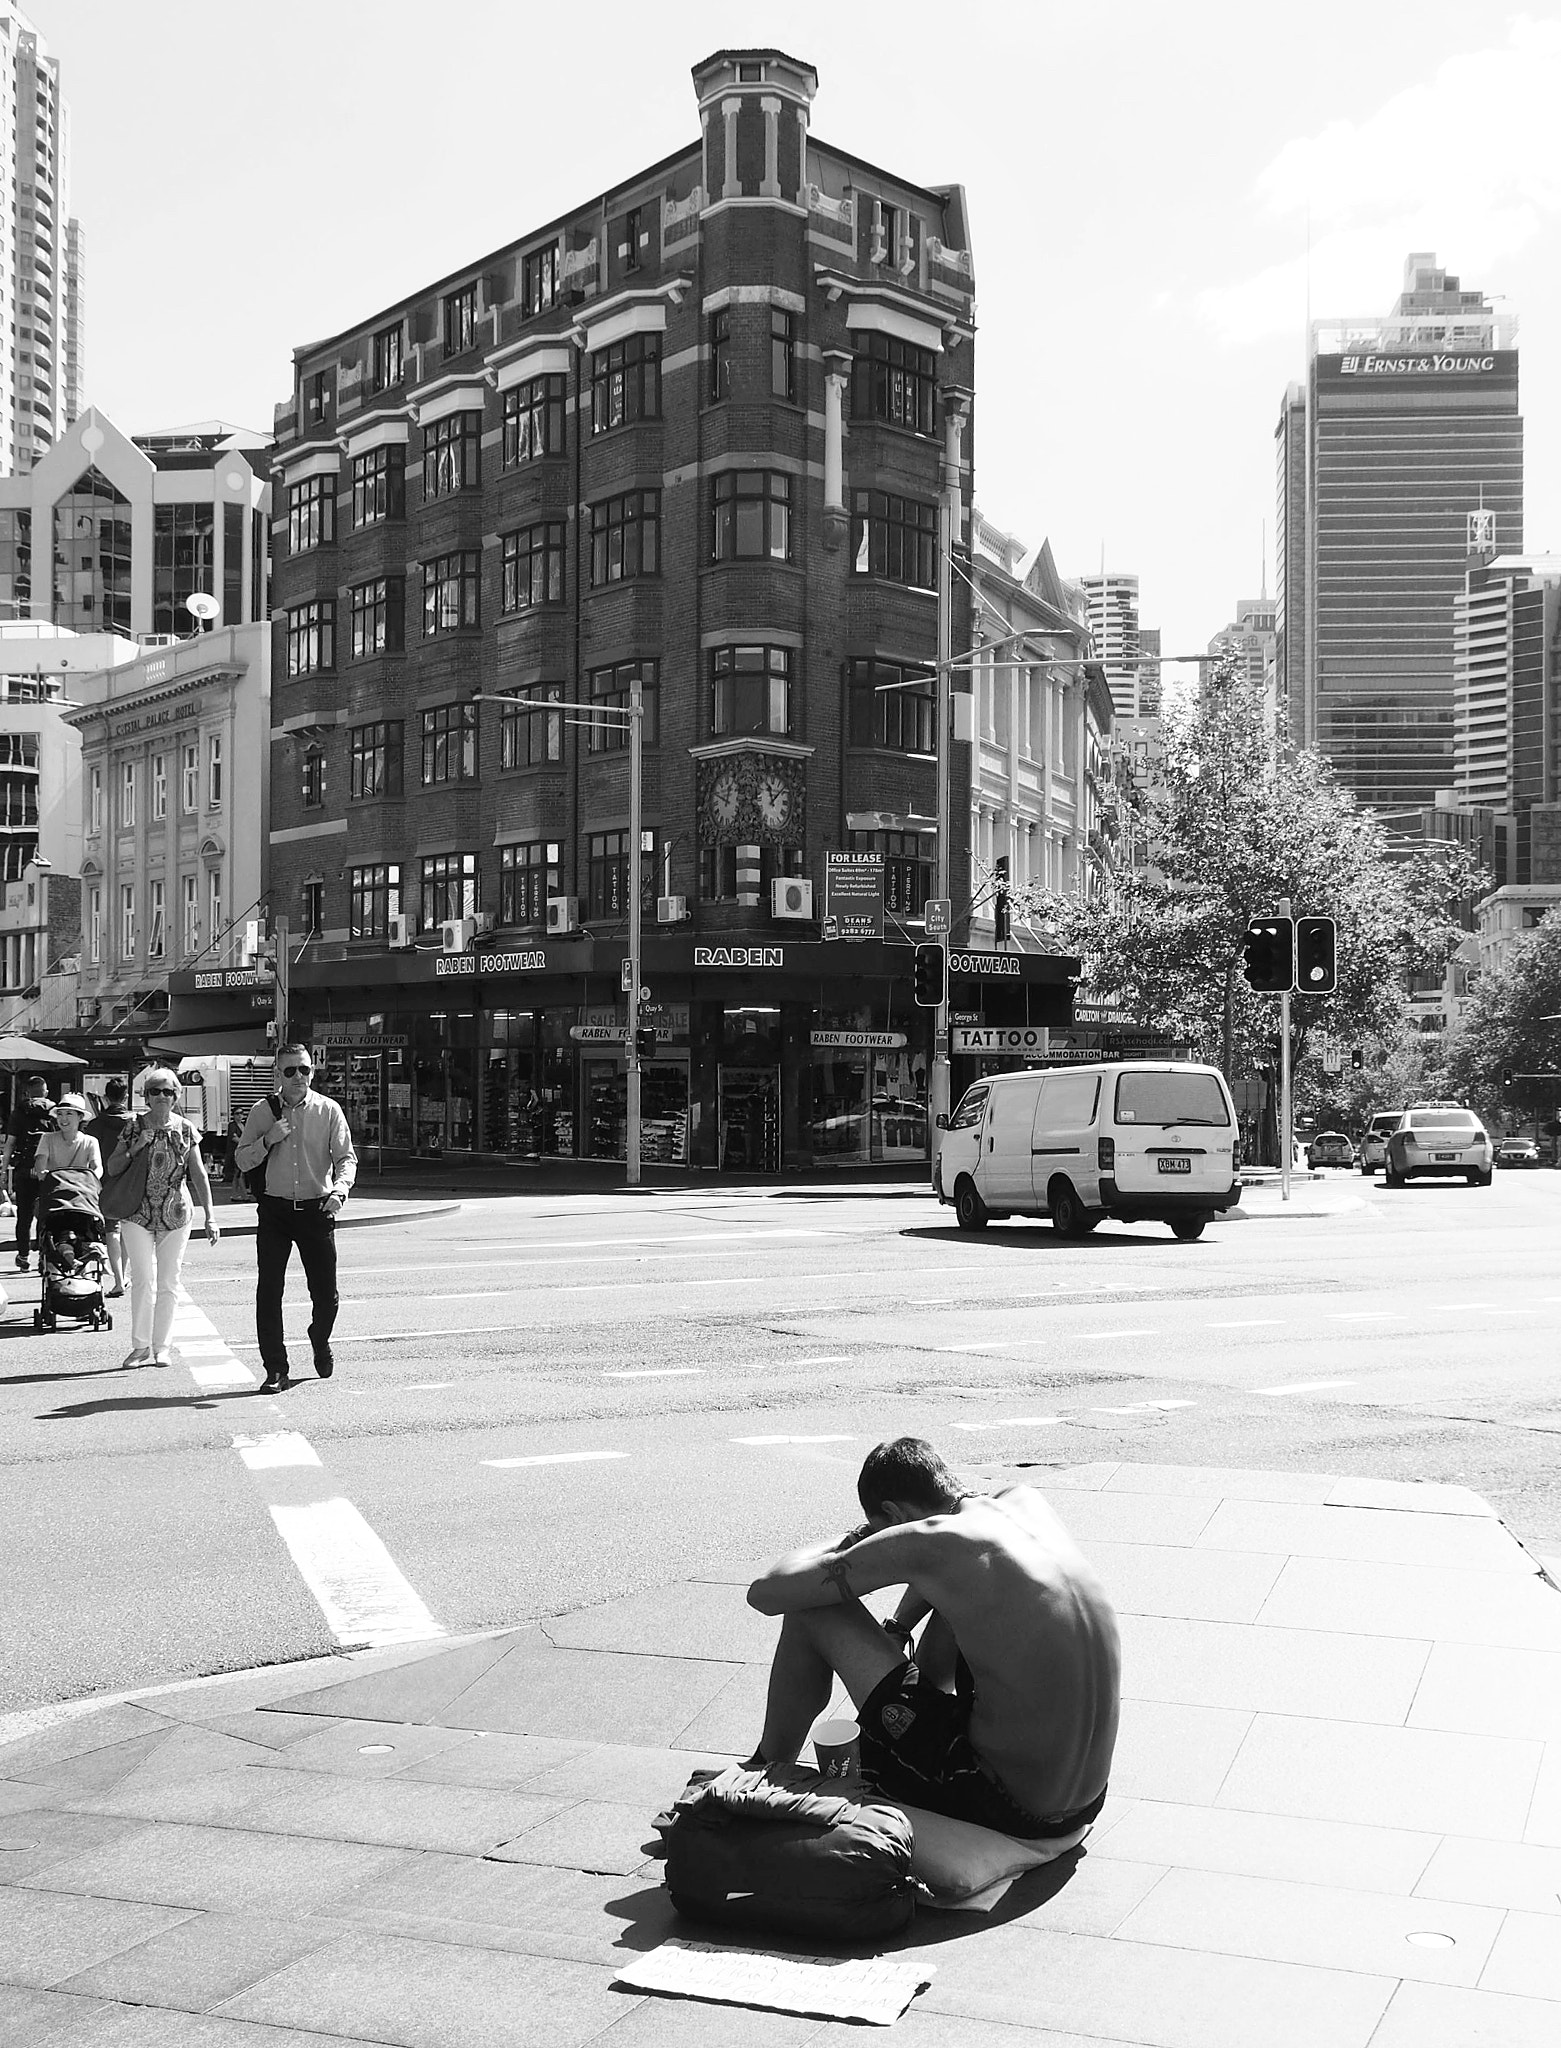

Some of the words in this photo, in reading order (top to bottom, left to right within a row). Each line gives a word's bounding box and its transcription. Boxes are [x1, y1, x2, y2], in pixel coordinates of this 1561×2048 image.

[1364, 356, 1414, 373] ERNST
[1418, 360, 1430, 372] &
[1432, 355, 1494, 372] YOUNG
[146, 709, 170, 727] PALACE
[175, 702, 195, 720] HOTEL
[831, 854, 850, 863] FOR
[852, 854, 881, 863] LEASE
[930, 915, 945, 923] City
[929, 923, 947, 931] South
[695, 947, 783, 966] RABEN
[436, 956, 475, 976] RABEN
[480, 951, 546, 973] FOOTWEAR
[625, 962, 631, 975] P
[948, 953, 1021, 975] OOTWEAR
[195, 973, 222, 988] RABEN
[645, 1004, 657, 1013] Quay
[954, 1013, 972, 1023] George
[972, 1013, 979, 1023] St
[1075, 1009, 1100, 1022] CARLTON
[582, 1028, 611, 1038] RABEN
[813, 1033, 840, 1043] RABEN
[845, 1034, 893, 1045] FOOTWEAR
[960, 1031, 1038, 1047] TATTOO
[327, 1036, 353, 1045] RABEN
[360, 1035, 405, 1045] FOOTWEAR
[1102, 1051, 1120, 1060] BAR
